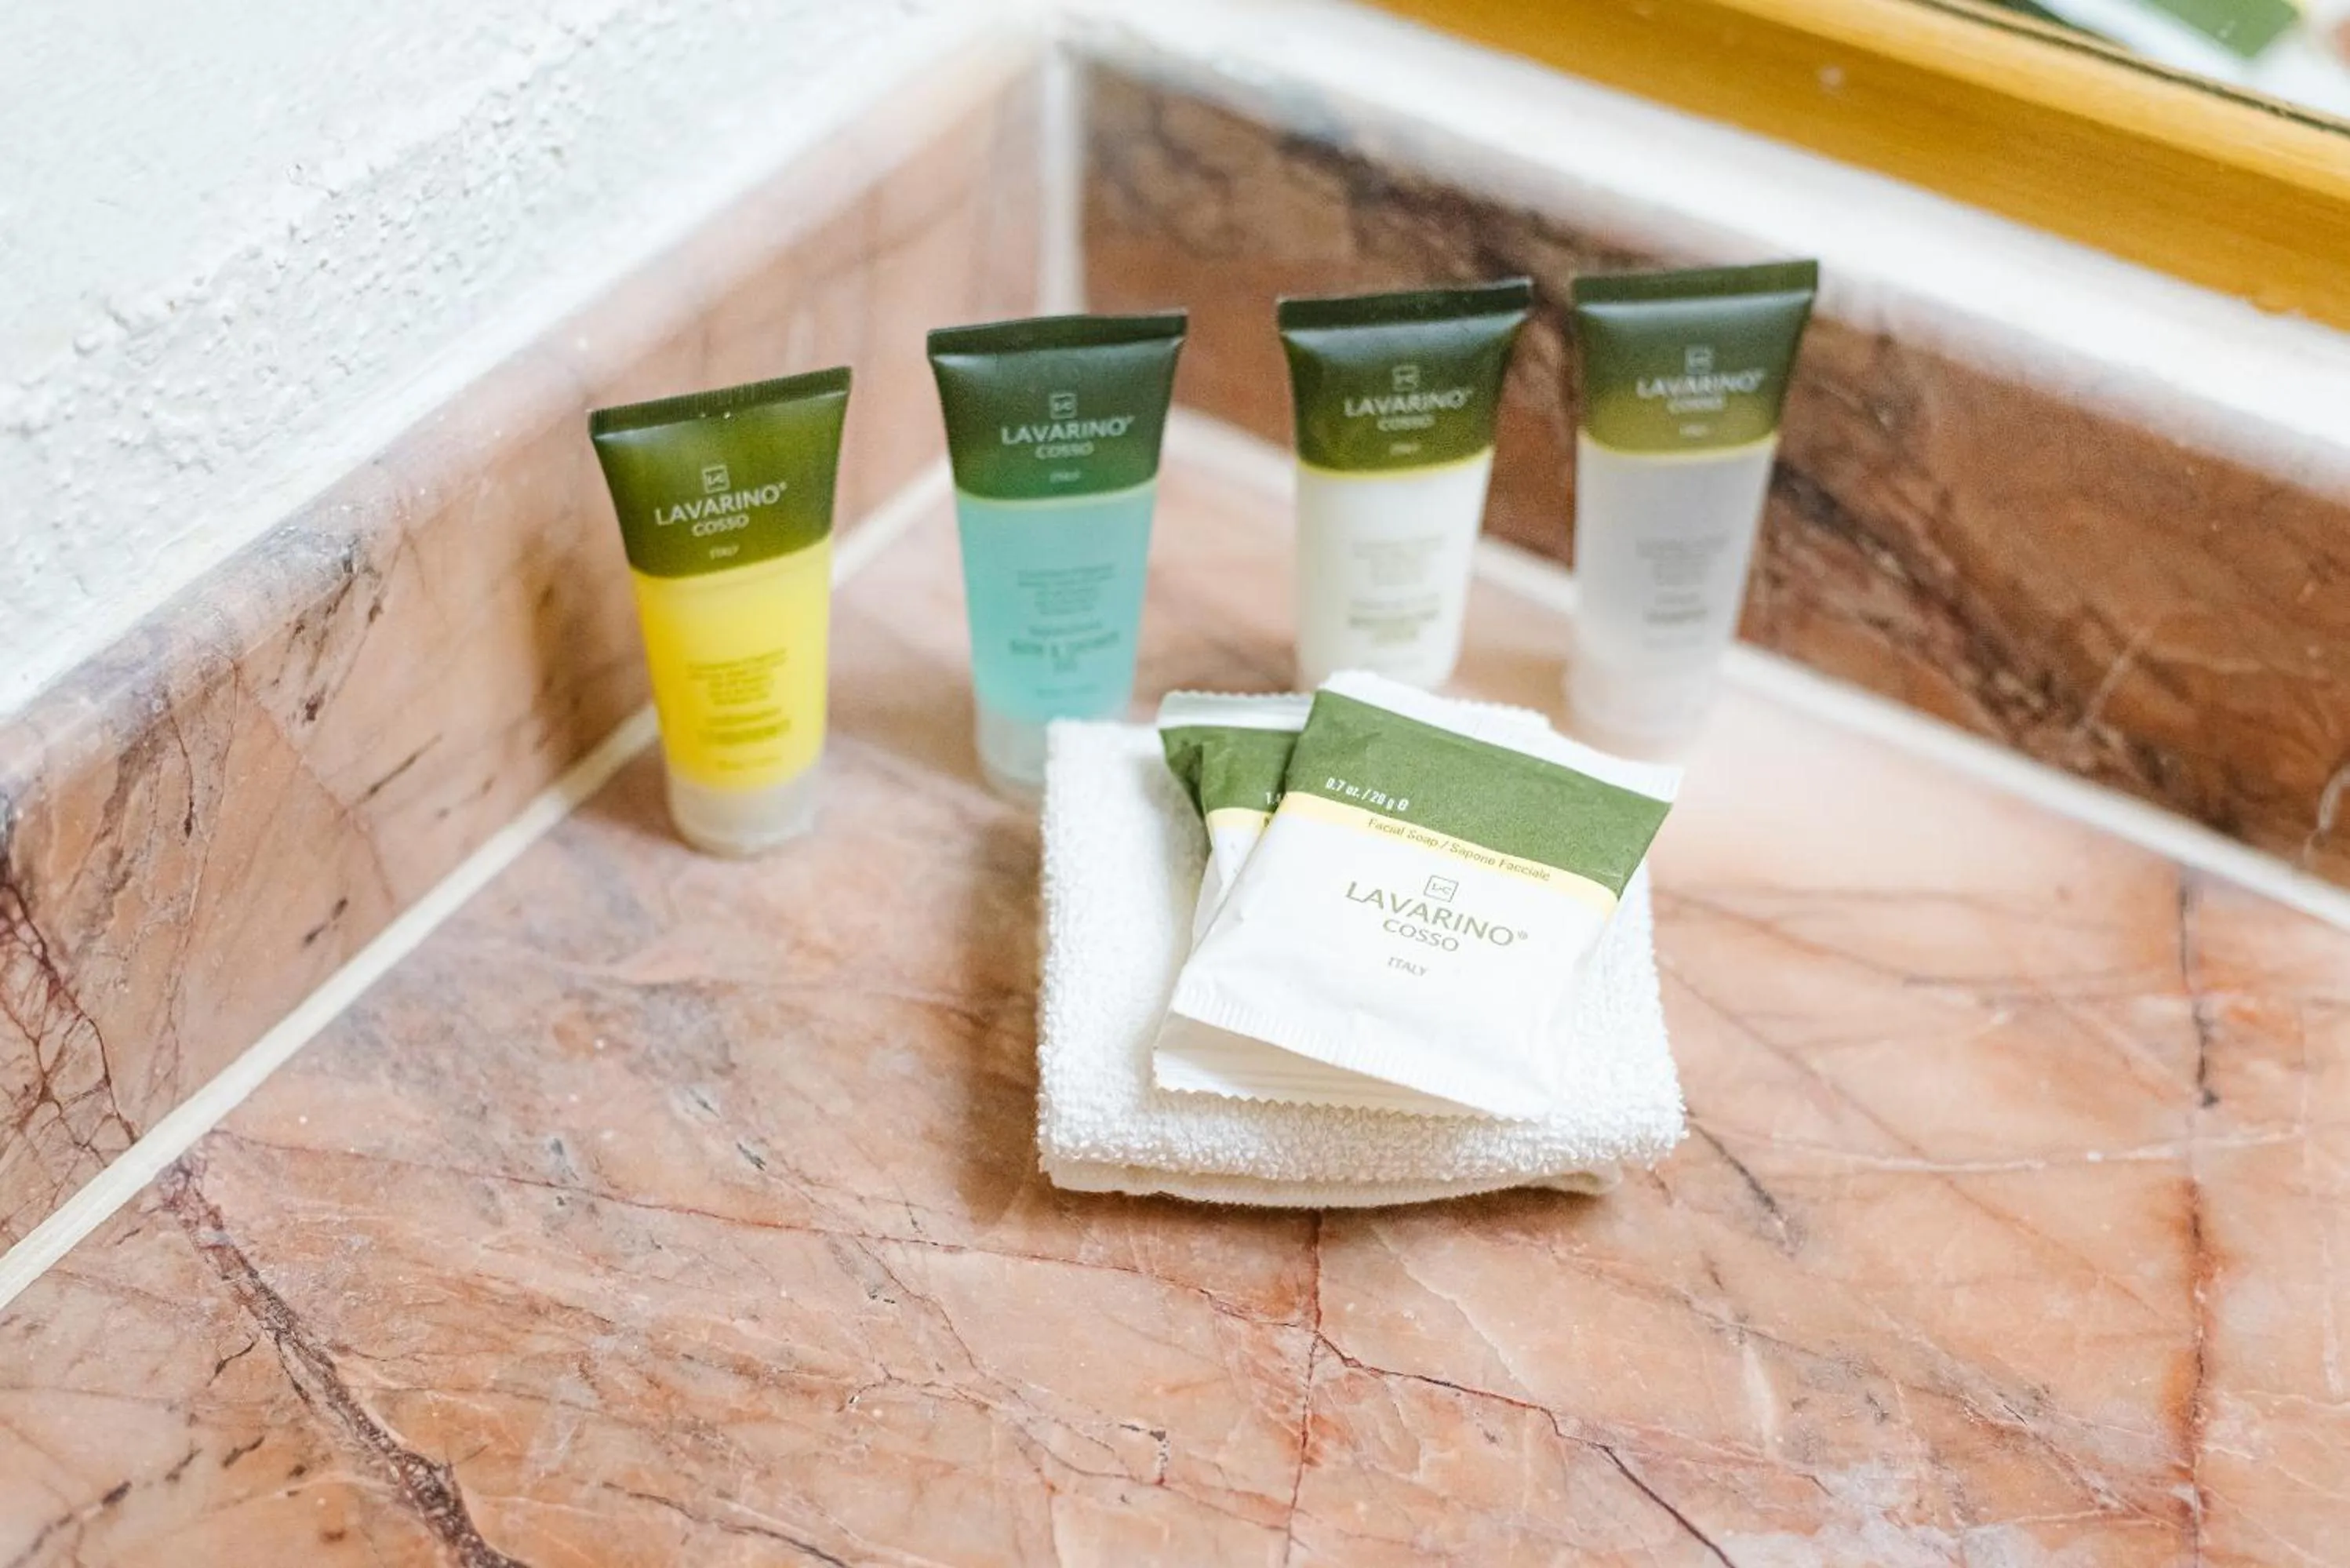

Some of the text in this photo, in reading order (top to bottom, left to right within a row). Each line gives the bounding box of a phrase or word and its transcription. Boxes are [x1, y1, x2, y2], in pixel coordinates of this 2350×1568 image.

[1001, 417, 1128, 445] LAVARINO
[654, 484, 780, 526] LAVARINO
[692, 514, 750, 537] COSSO
[1326, 776, 1347, 792] 0.7
[1369, 818, 1406, 836] Facial
[1406, 829, 1439, 848] Soap
[1450, 842, 1497, 866] Sapone
[1498, 858, 1551, 882] Facciale
[1382, 919, 1460, 952] COSSO
[1388, 956, 1428, 977] ITALY
